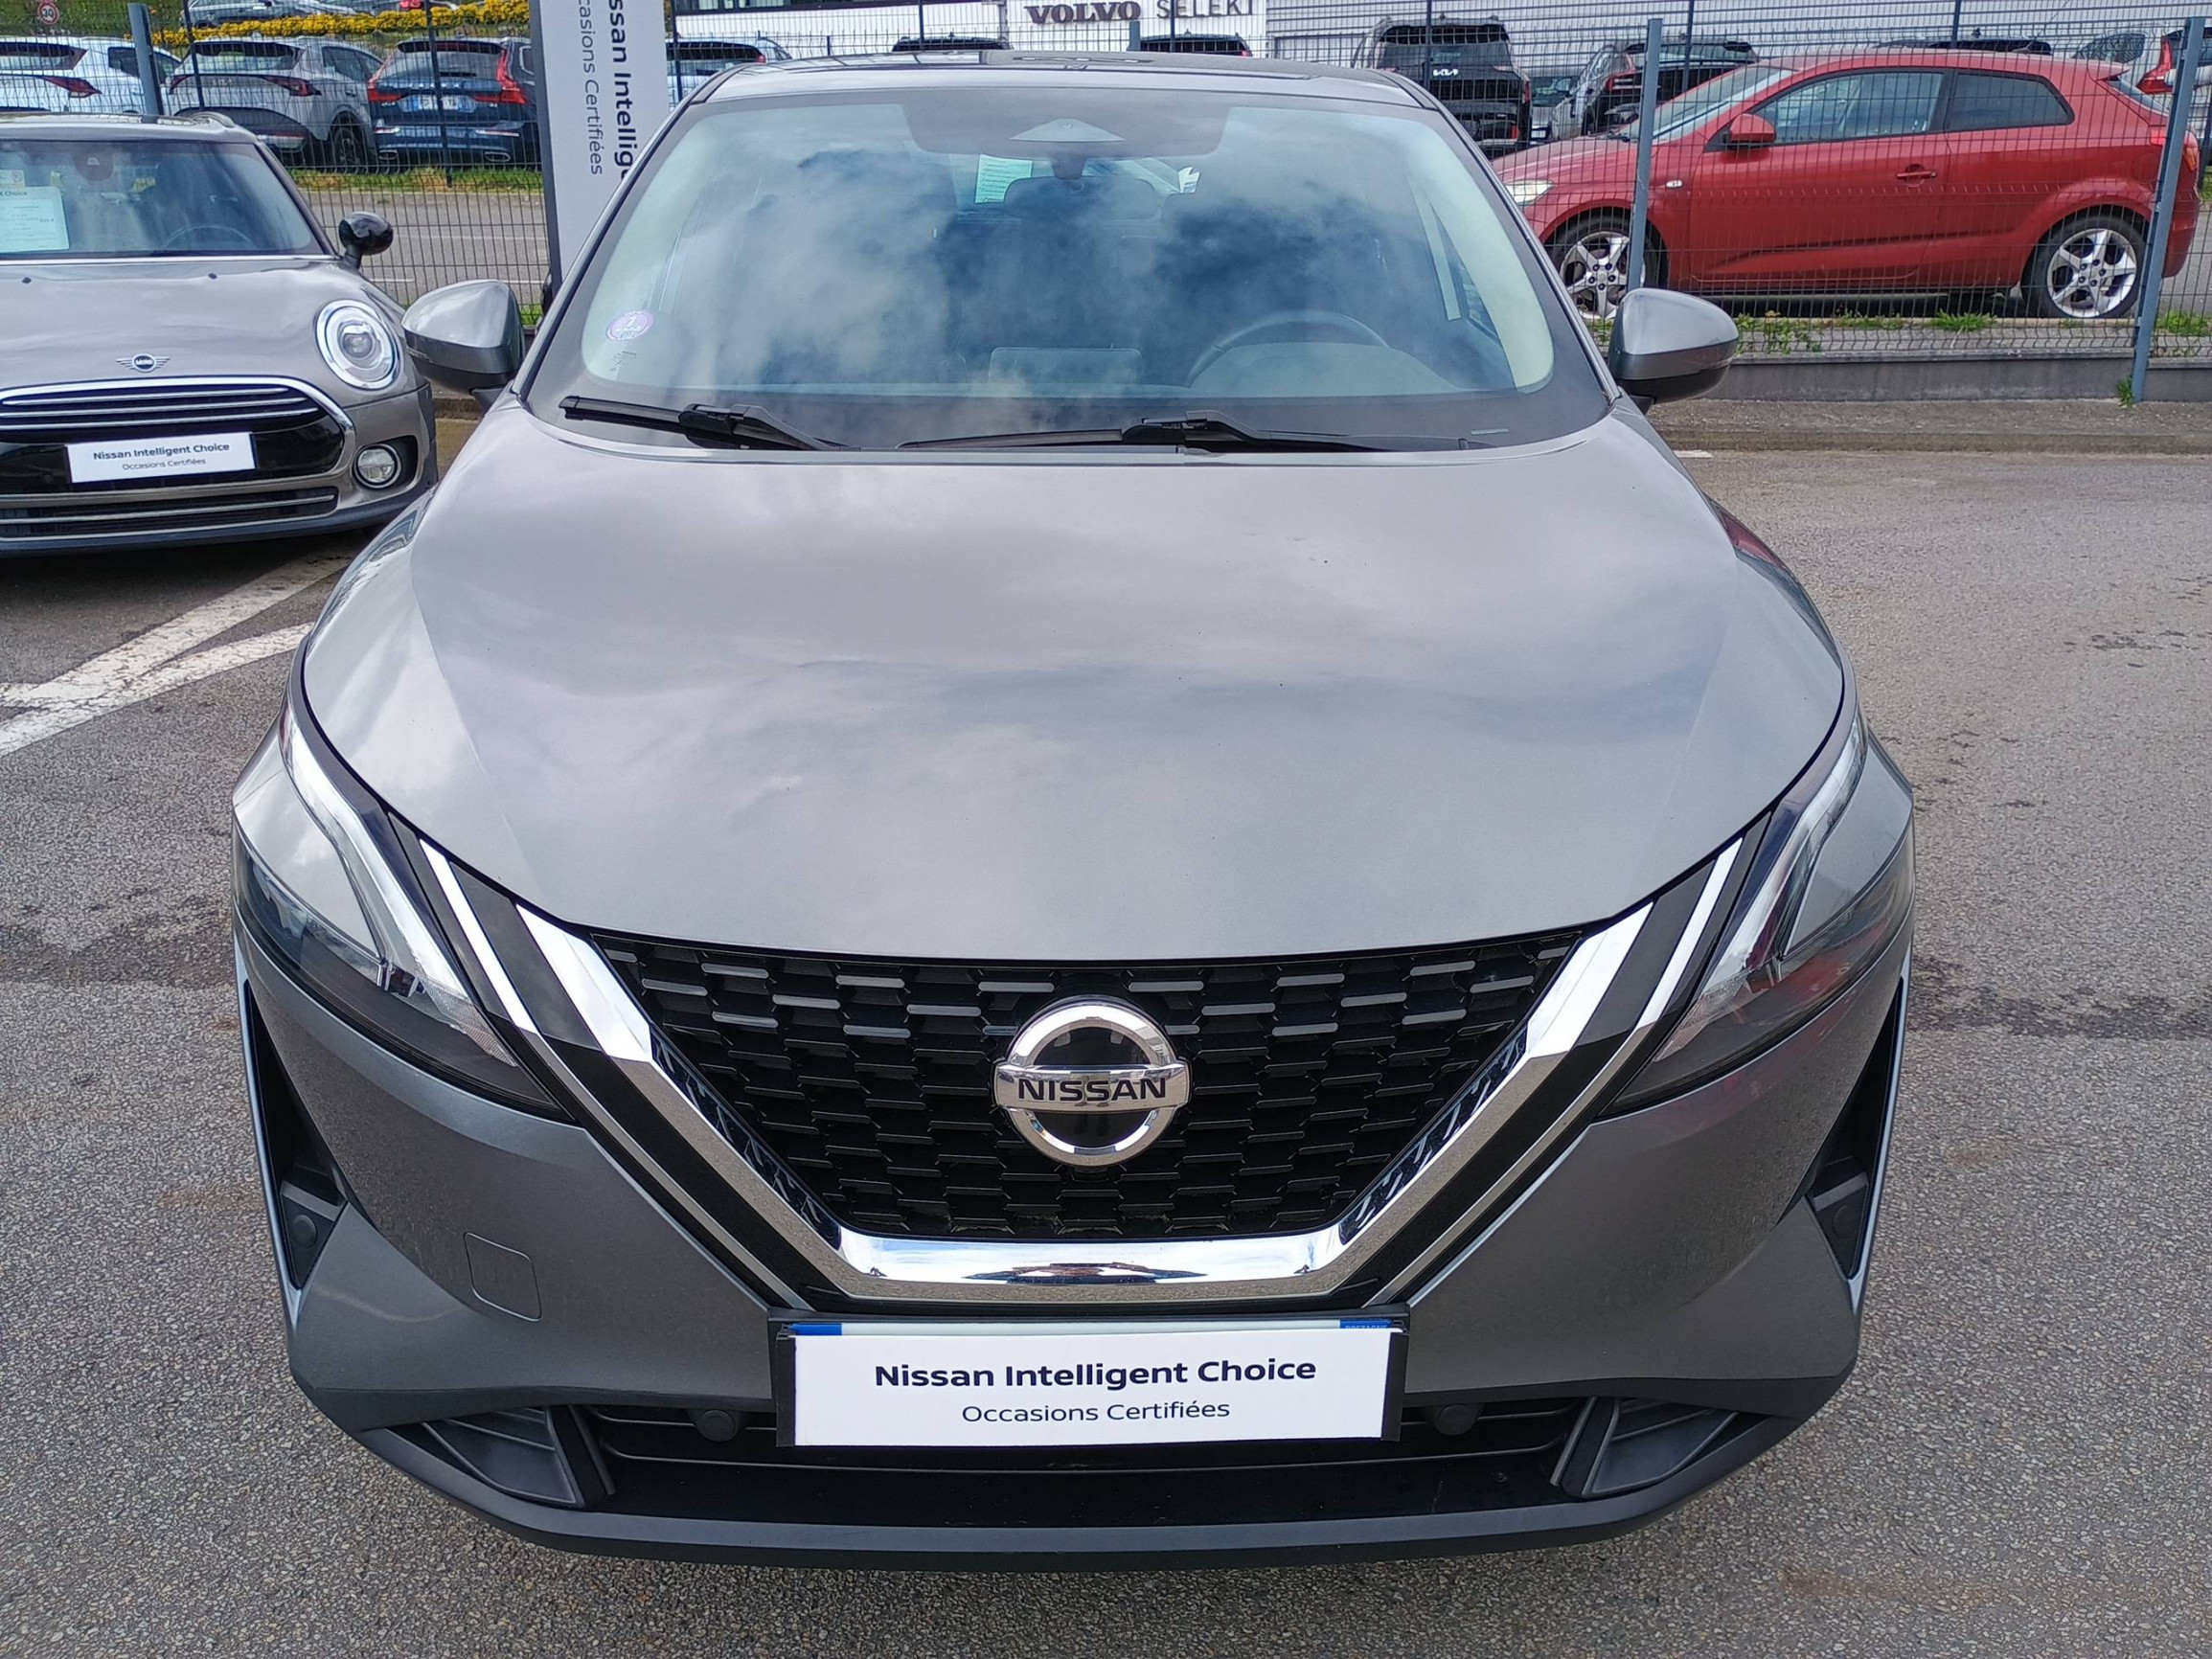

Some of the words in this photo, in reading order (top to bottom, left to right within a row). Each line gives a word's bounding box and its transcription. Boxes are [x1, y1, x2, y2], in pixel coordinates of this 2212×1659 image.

[1023, 1, 1141, 25] VOLVO
[584, 80, 604, 175] Certifiées
[93, 450, 132, 461] Nissan
[134, 444, 191, 458] Intelligent
[194, 443, 230, 453] Choice
[122, 461, 166, 470] Occasions
[168, 458, 206, 467] Certifiées
[1017, 1078, 1166, 1102] NISSAN
[876, 1364, 994, 1387] Nissan
[1006, 1362, 1188, 1391] Intelligent
[1197, 1358, 1316, 1382] Choice
[962, 1405, 1099, 1422] Occasions
[1106, 1400, 1230, 1420] Certifiées
